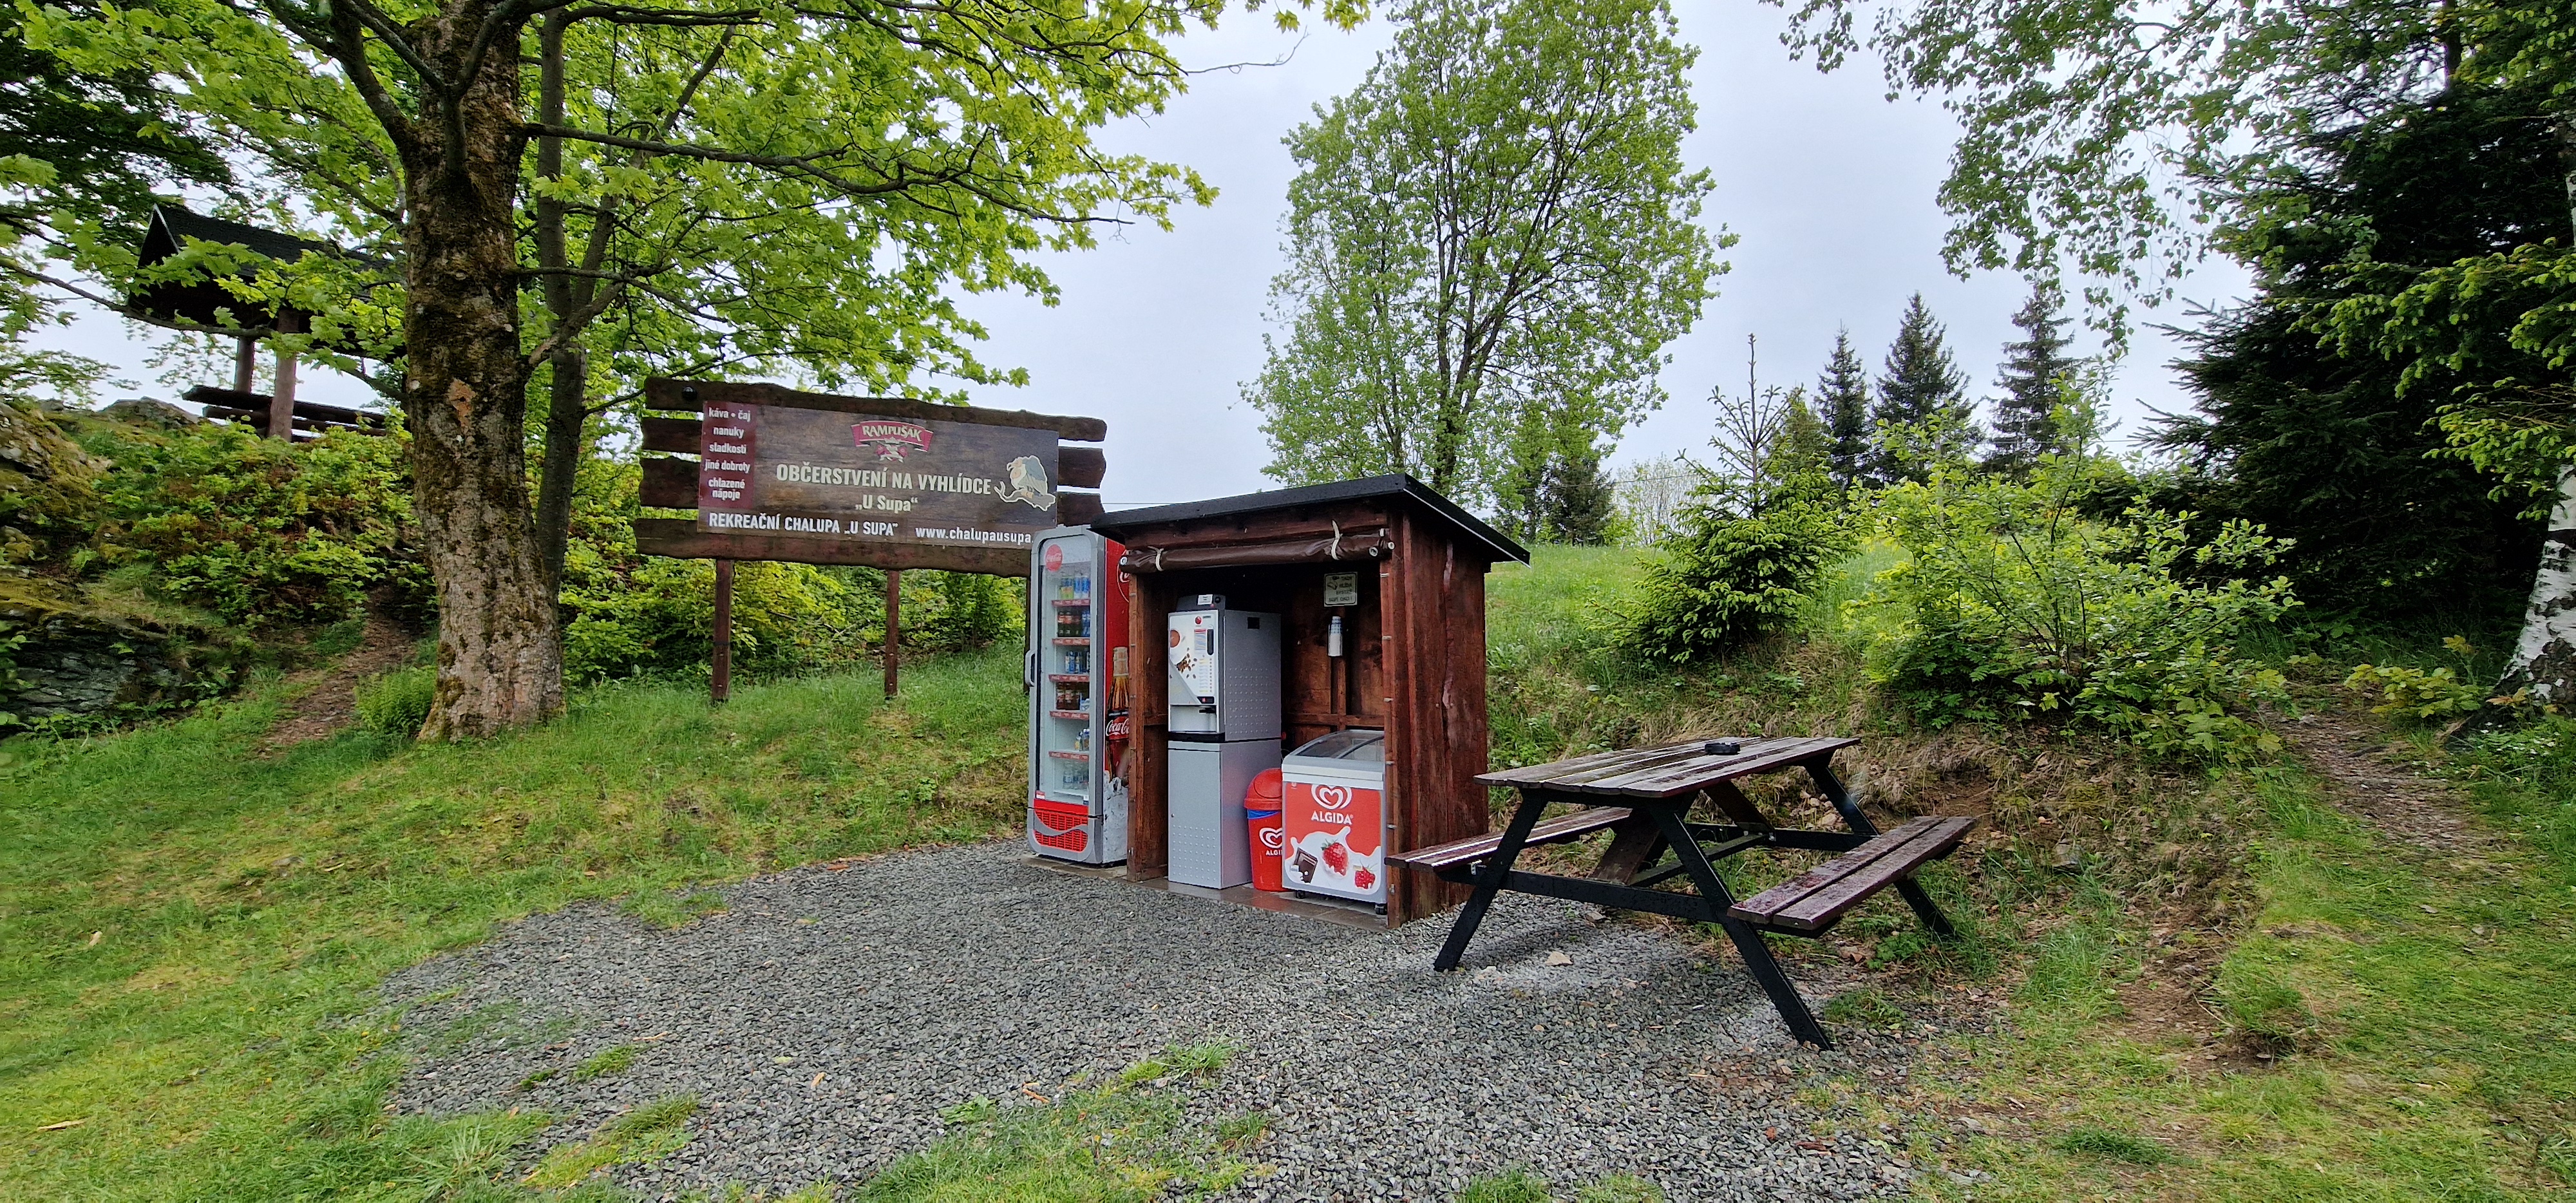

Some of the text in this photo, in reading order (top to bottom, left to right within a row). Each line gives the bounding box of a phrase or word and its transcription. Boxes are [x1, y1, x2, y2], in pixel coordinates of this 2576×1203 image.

[709, 407, 751, 422] káva čaj
[713, 426, 744, 439] nanuky
[862, 424, 923, 442] RAMPUŠÁK
[709, 442, 747, 454] sladkosti
[704, 459, 750, 474] jiné dobroty
[708, 477, 745, 489] chlazené
[776, 461, 992, 495] OBČERSTVENÍ NA VYHLÍDCE
[712, 488, 741, 500] nápoje
[709, 512, 781, 530] REKREAČNÍ
[784, 516, 840, 533] CHALUPA
[915, 526, 1034, 545] www.chalupausupa.
